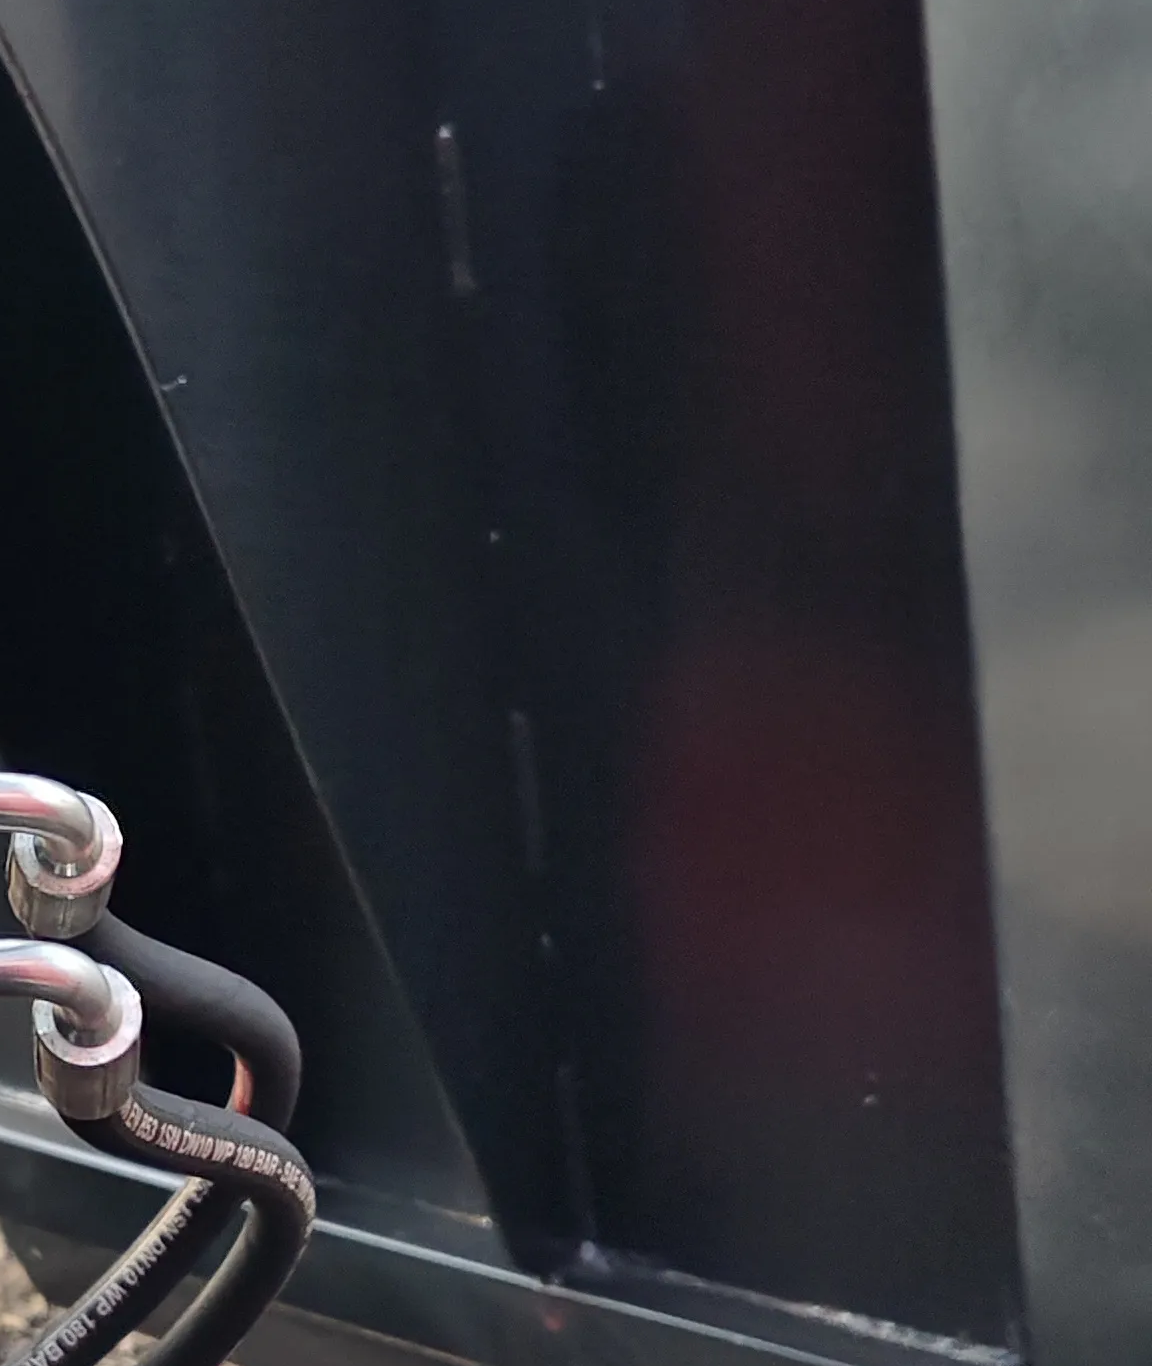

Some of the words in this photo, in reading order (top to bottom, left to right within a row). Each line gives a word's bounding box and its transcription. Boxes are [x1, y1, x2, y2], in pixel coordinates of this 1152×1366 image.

[177, 1129, 215, 1160] DN10
[211, 1137, 236, 1163] WP
[232, 1143, 257, 1170] 180
[252, 1149, 280, 1177] BAR
[280, 1160, 302, 1191] SAE
[123, 1238, 167, 1286] DN10
[95, 1281, 128, 1316] WP
[61, 1313, 97, 1348] 180
